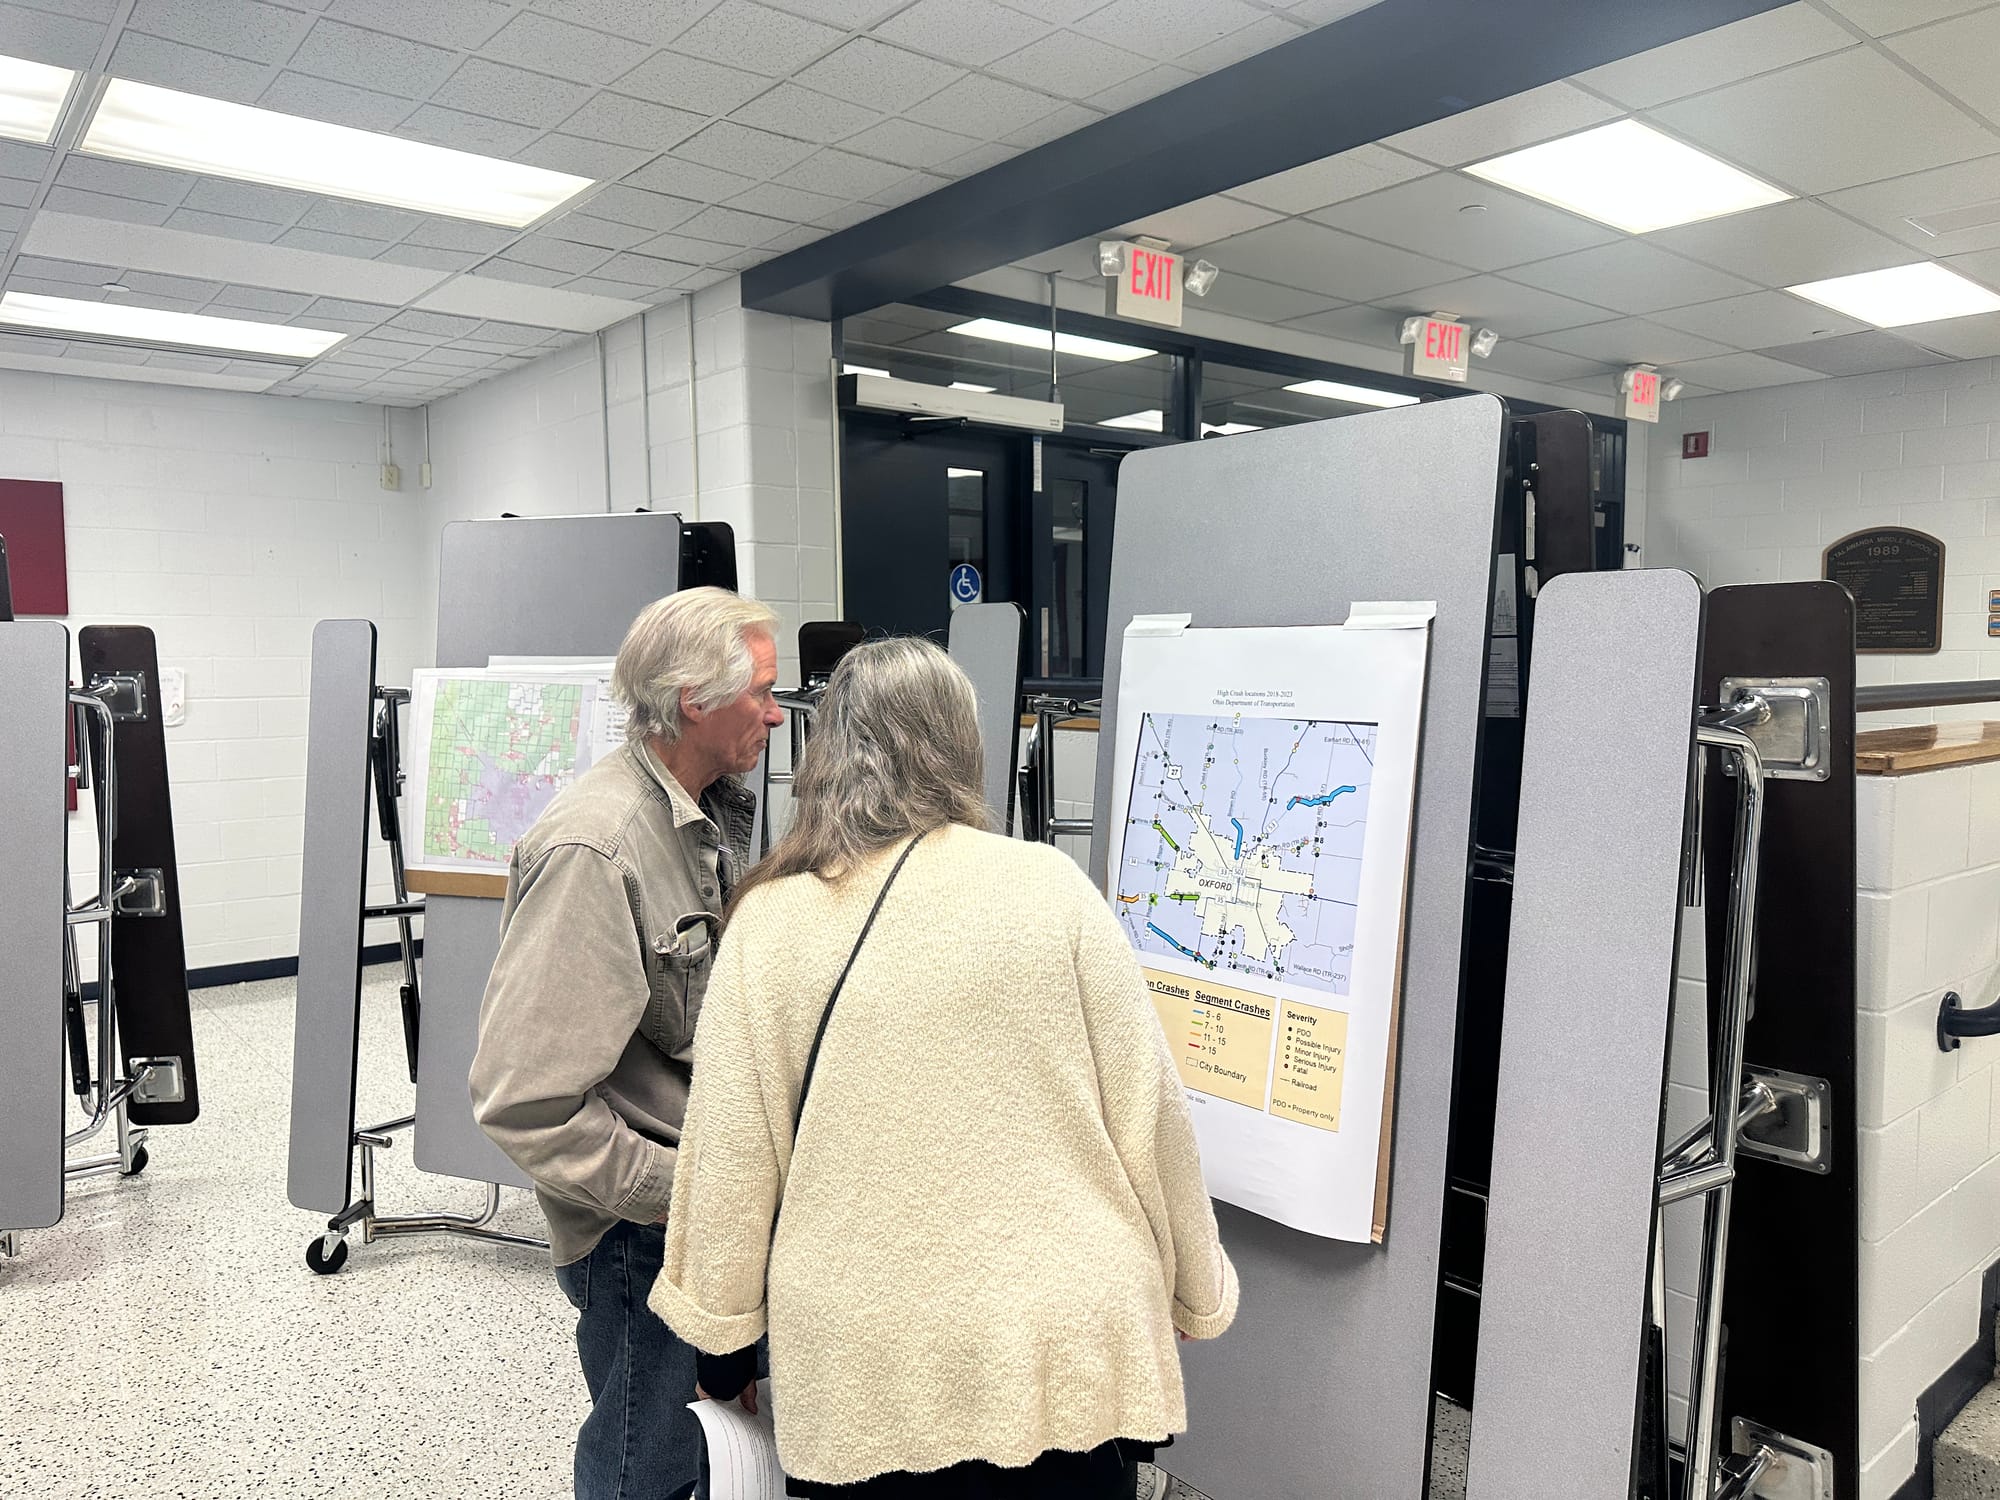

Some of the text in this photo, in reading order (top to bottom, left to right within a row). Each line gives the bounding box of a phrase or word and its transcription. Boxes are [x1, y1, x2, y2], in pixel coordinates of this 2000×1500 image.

[1132, 248, 1174, 301] EXIT
[1425, 322, 1463, 362] EXIT
[1633, 369, 1656, 406] EXIT
[1867, 545, 1900, 557] 1989
[1877, 536, 1903, 544] MIDDLE
[1906, 538, 1932, 554] SCHOOL
[1217, 689, 1229, 697] High
[1263, 770, 1268, 778] RD
[1198, 878, 1232, 891] OXFORD
[1293, 963, 1312, 973] Wallace
[1322, 970, 1347, 981] (TR-237)
[1156, 981, 1190, 997] Crashes
[1195, 990, 1271, 1017] Segment Crashes
[1216, 1013, 1221, 1021] 6
[1286, 1010, 1317, 1026] Severity
[1216, 1025, 1224, 1034] 10
[1296, 1028, 1311, 1037] PDO
[1204, 1033, 1211, 1042] 11
[1218, 1037, 1226, 1046] 15
[1295, 1037, 1341, 1055] Possible Injury
[1208, 1046, 1217, 1055] 15
[1294, 1047, 1331, 1062] Minor Injury
[1199, 1061, 1247, 1083] City Boundary
[1293, 1056, 1336, 1073] Serious Injury
[1293, 1065, 1308, 1074] Fatal
[1291, 1078, 1317, 1091] Railroad
[1272, 1099, 1287, 1108] PDO
[1292, 1104, 1318, 1118] Property
[1319, 1112, 1334, 1122] only
